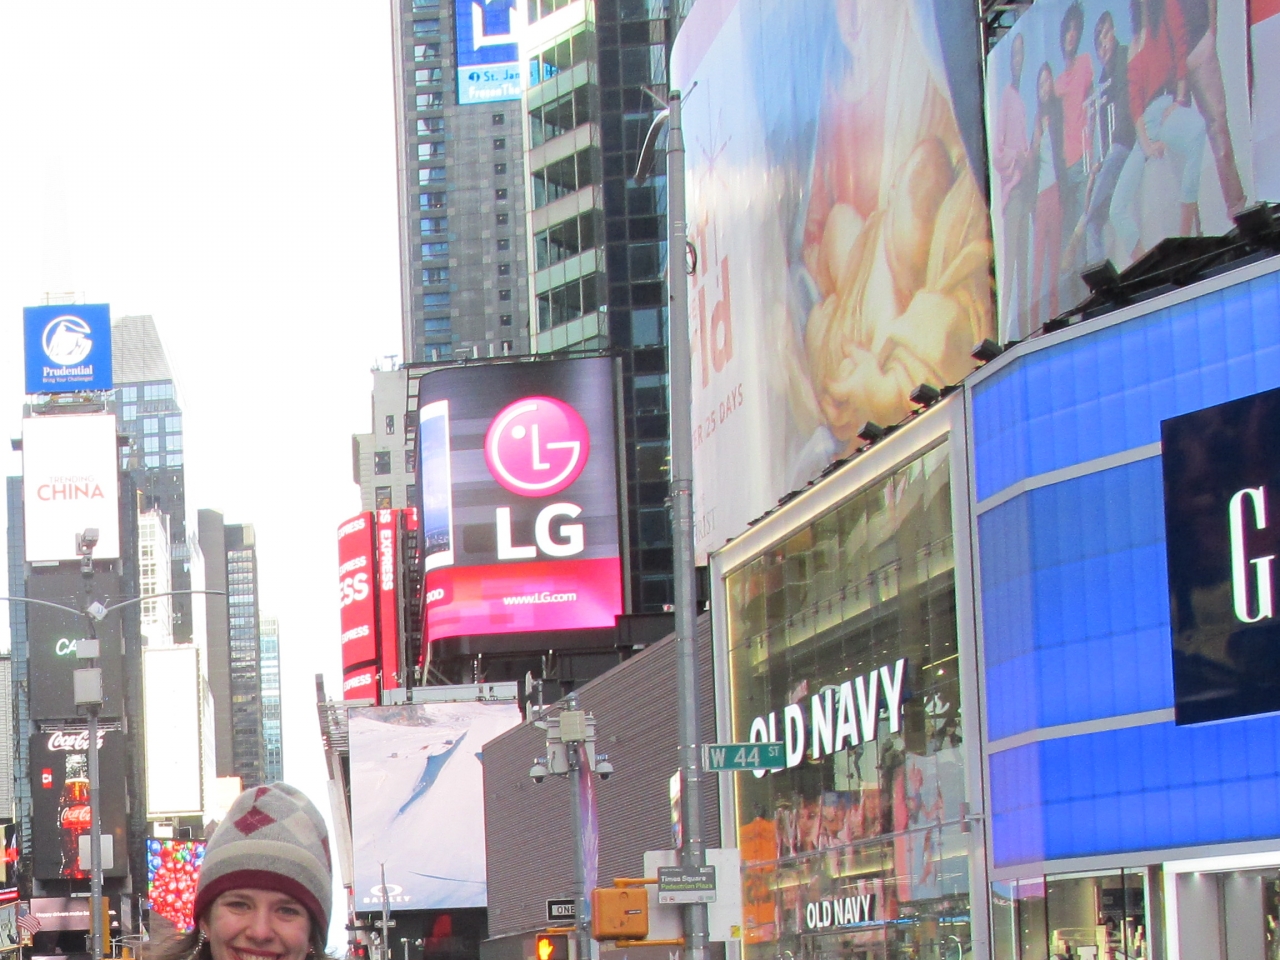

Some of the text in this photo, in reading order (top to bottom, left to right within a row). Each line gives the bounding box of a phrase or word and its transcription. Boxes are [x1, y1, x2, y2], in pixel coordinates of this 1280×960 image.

[43, 364, 94, 377] Prudential
[719, 382, 744, 425] DAYS
[37, 483, 105, 501] CHINA
[495, 502, 585, 560] LG
[380, 529, 394, 591] EXPRESS
[503, 591, 577, 606] www.LG.com
[812, 658, 908, 760] NAVY
[48, 730, 106, 750] Coca-Coa
[711, 745, 780, 768] W 44 ST
[682, 875, 706, 883] Square
[363, 895, 411, 904] OALEY
[557, 906, 576, 915] ONE
[806, 894, 870, 928] OLD NAVY
